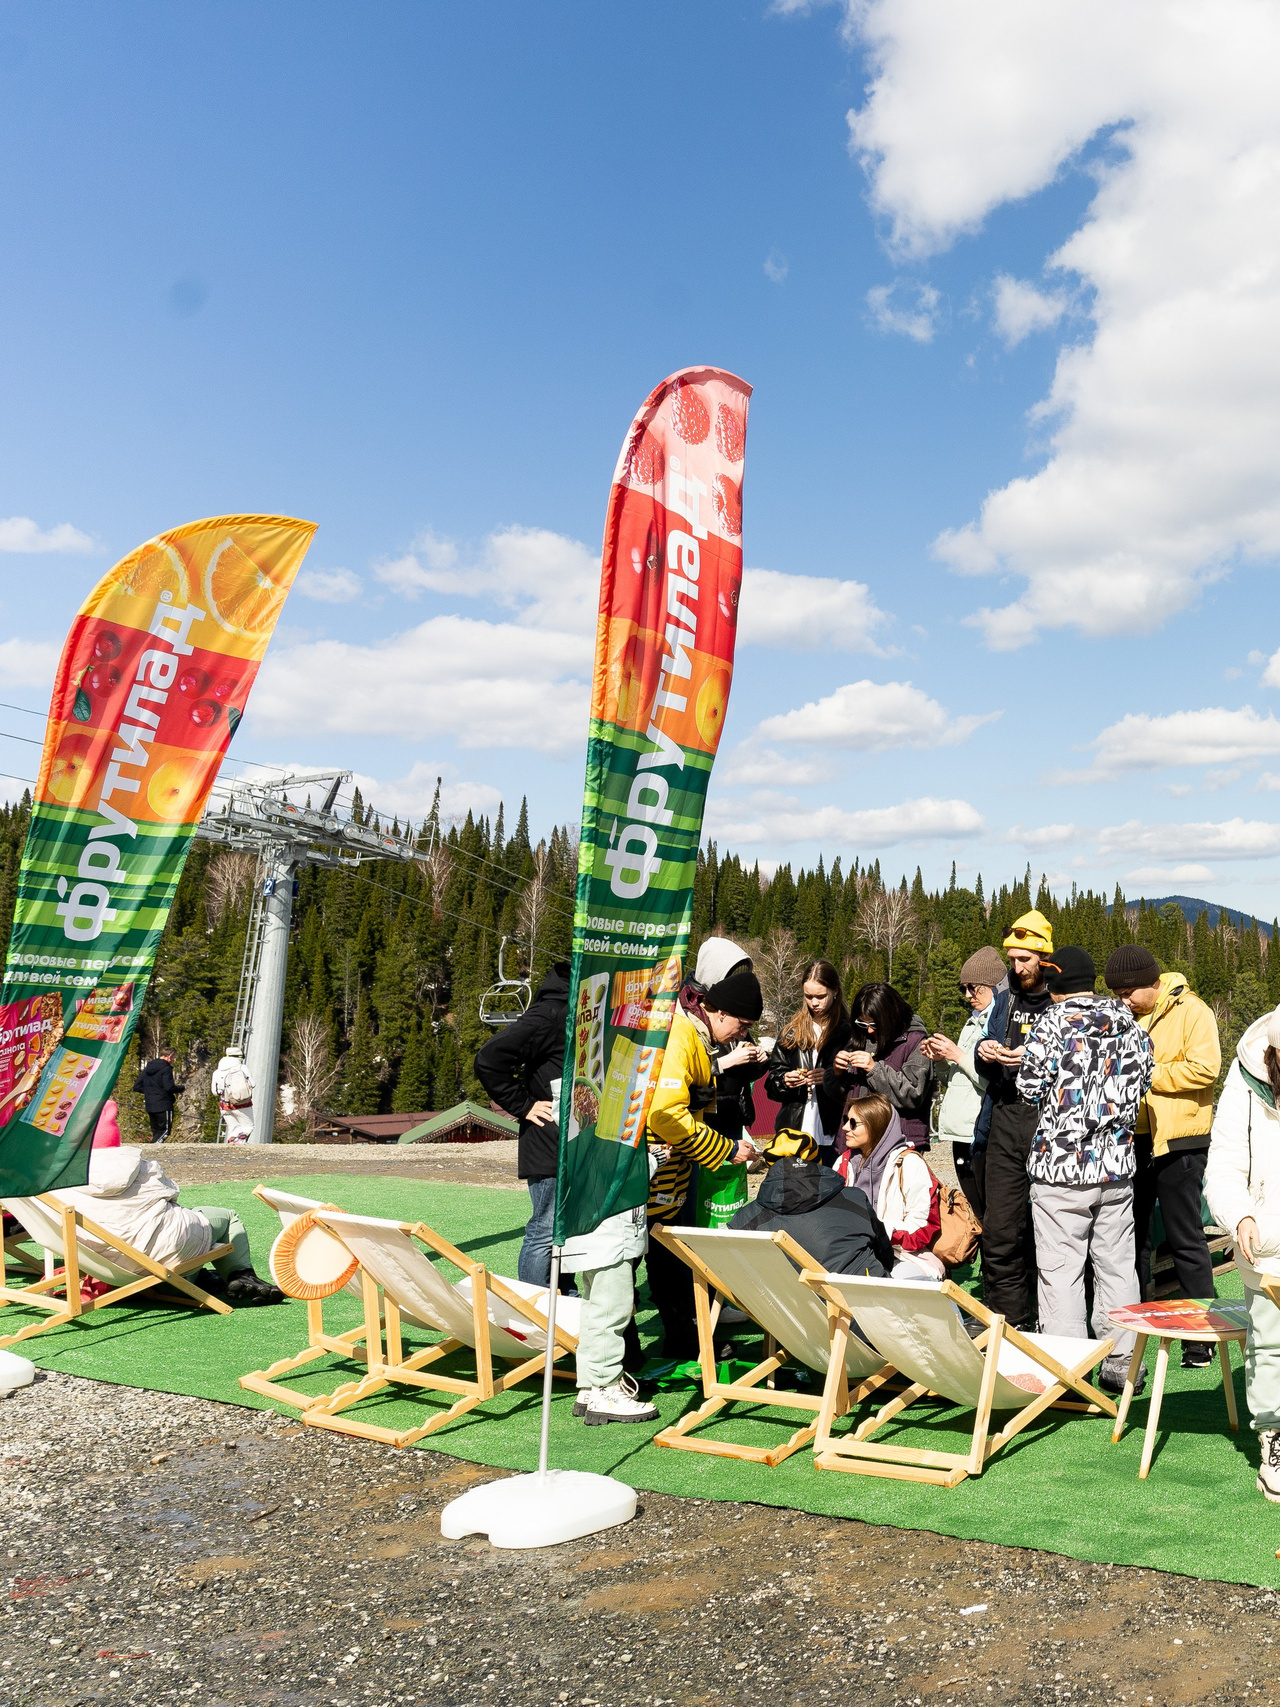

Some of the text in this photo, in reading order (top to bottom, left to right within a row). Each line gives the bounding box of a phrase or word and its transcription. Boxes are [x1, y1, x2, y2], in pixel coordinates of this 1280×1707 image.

[265, 880, 273, 894] 2
[613, 940, 659, 957] семьи
[64, 975, 98, 987] сем
